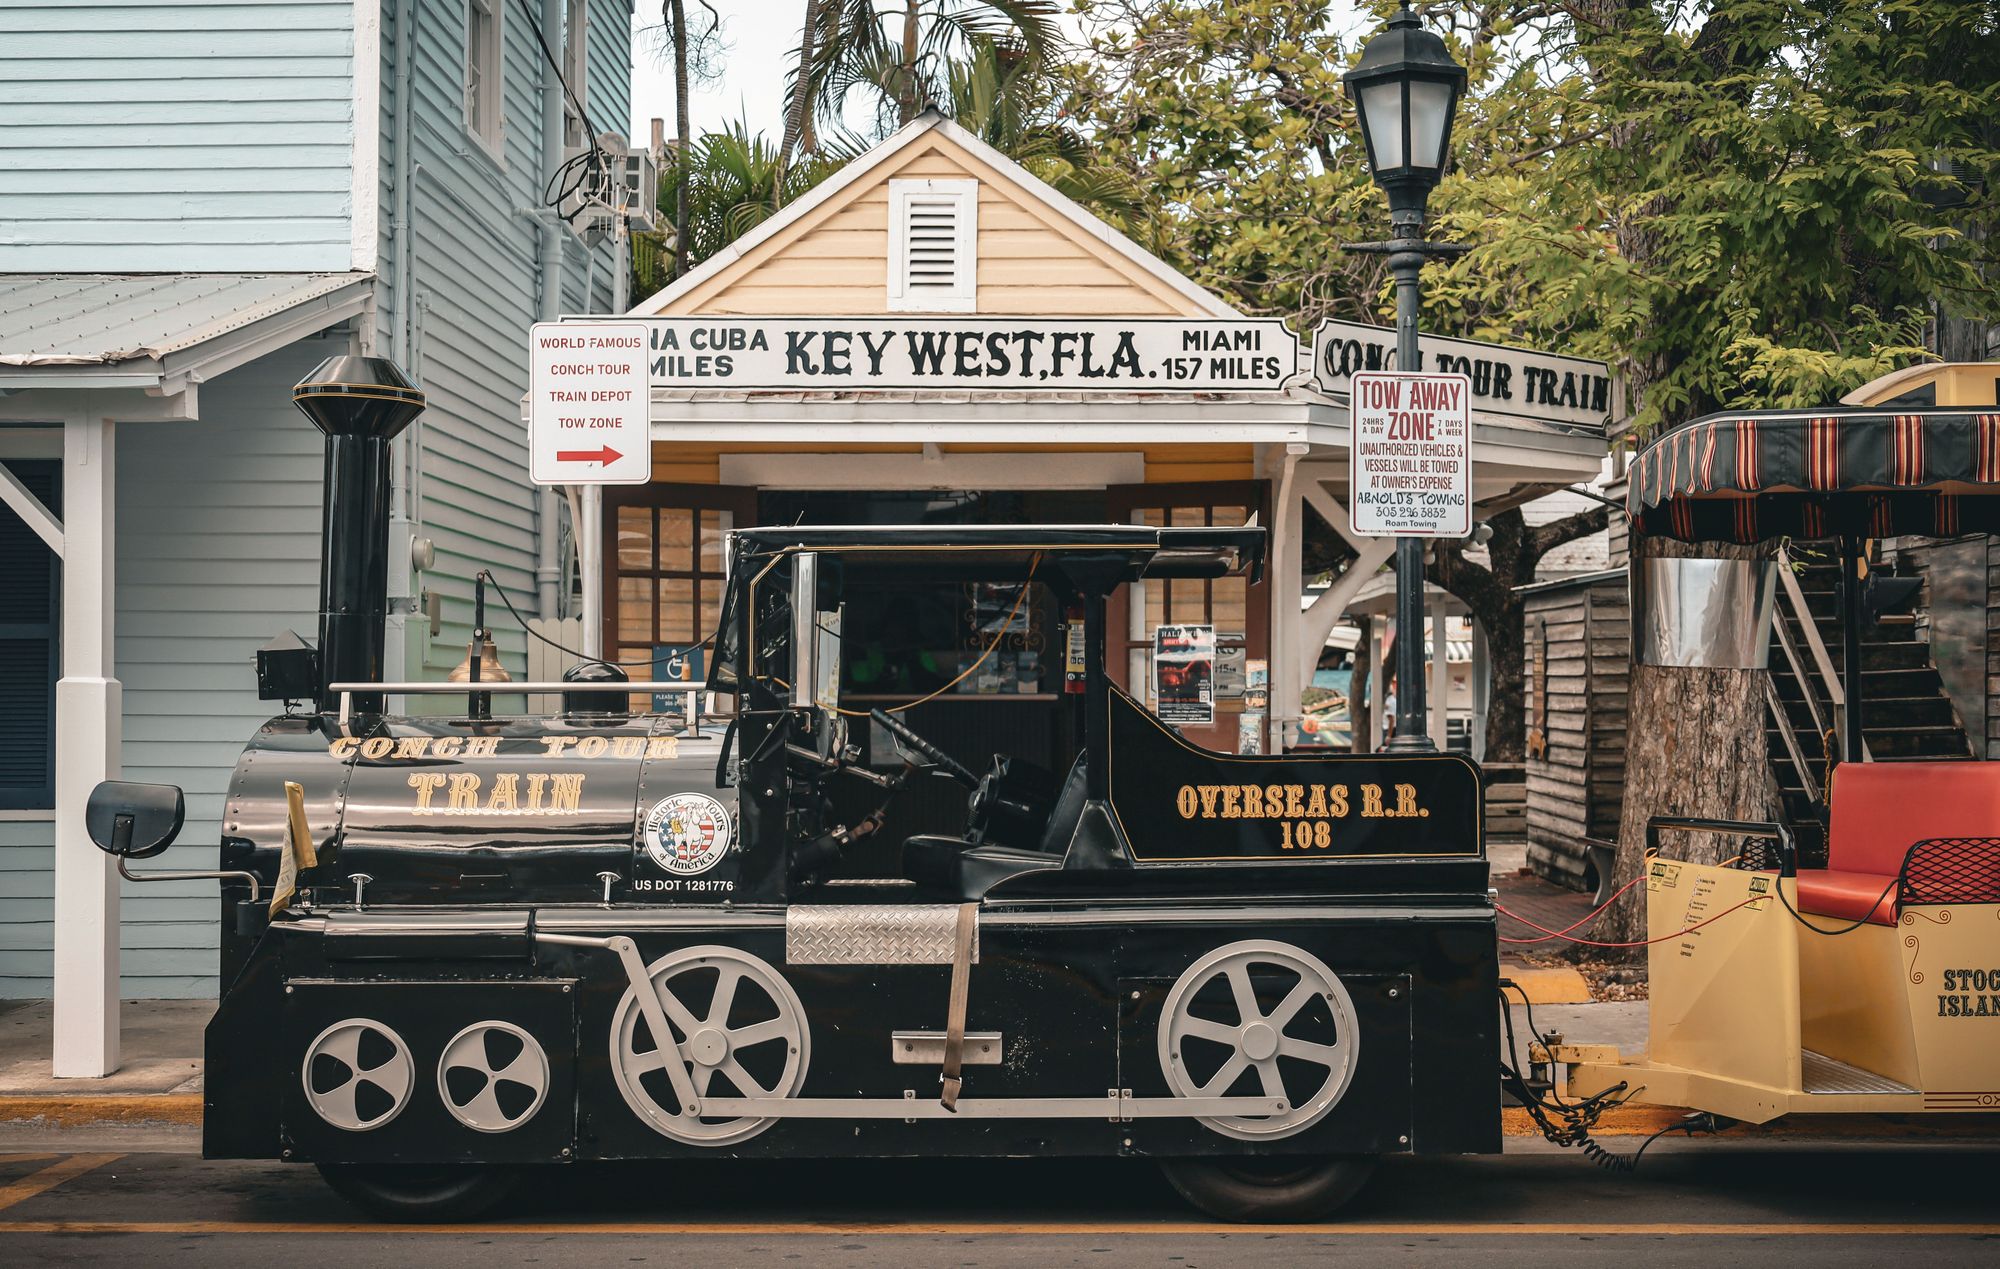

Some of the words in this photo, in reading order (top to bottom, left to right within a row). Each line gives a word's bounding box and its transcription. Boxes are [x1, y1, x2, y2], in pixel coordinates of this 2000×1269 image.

[540, 338, 586, 349] WORLD
[588, 337, 641, 348] FAMOUS
[690, 328, 769, 351] CUBA
[1182, 330, 1261, 351] MIAMI
[784, 331, 897, 377] KEY
[551, 364, 594, 375] CONCH
[597, 364, 631, 375] TOUR
[1161, 358, 1203, 380] 157
[1210, 357, 1281, 380] MILES
[1324, 338, 1424, 377] CON
[1523, 366, 1609, 412] TRAIN
[549, 391, 587, 402] TRAIN
[591, 391, 632, 401] DEPOT
[1360, 381, 1402, 410] TOW
[1409, 381, 1461, 411] AWAY
[558, 418, 586, 429] TOW
[589, 417, 623, 428] ZONE
[1362, 417, 1385, 426] 24HRS
[1362, 426, 1368, 435] A
[1370, 426, 1384, 435] DAY
[1387, 411, 1435, 441] ZONE
[1437, 420, 1443, 428] 7
[1445, 420, 1463, 428] DAYS
[1437, 428, 1443, 436] A
[1445, 428, 1463, 437] WEEK
[1360, 442, 1419, 457] UNAUTHORIZED
[1420, 443, 1456, 458] VEHICLES
[1457, 444, 1464, 458] &
[1365, 459, 1398, 472] VESSELS
[1400, 459, 1418, 473] WILL
[1420, 460, 1430, 473] BE
[1431, 460, 1459, 474] TOWED
[1370, 475, 1381, 489] AT
[1382, 476, 1418, 489] OWNER'S
[1420, 476, 1453, 490] EXPENSE
[1418, 493, 1465, 506] TOWING
[1385, 520, 1408, 528] Roam
[1409, 520, 1437, 529] Towing
[328, 736, 504, 759] CONCH
[540, 735, 679, 760] TOUR
[407, 772, 586, 816] TRAIN
[1176, 784, 1349, 819] OVERSEAS
[1360, 783, 1430, 817] R.R.
[648, 800, 683, 833] Historic
[704, 801, 726, 832] Tours
[1281, 820, 1331, 849] 108
[660, 852, 669, 861] of
[669, 852, 715, 871] America
[635, 880, 652, 891] US
[656, 880, 682, 891] DOT
[685, 880, 734, 892] 1281776
[1944, 968, 2000, 991] STOC
[1937, 994, 2000, 1017] ISLAN
